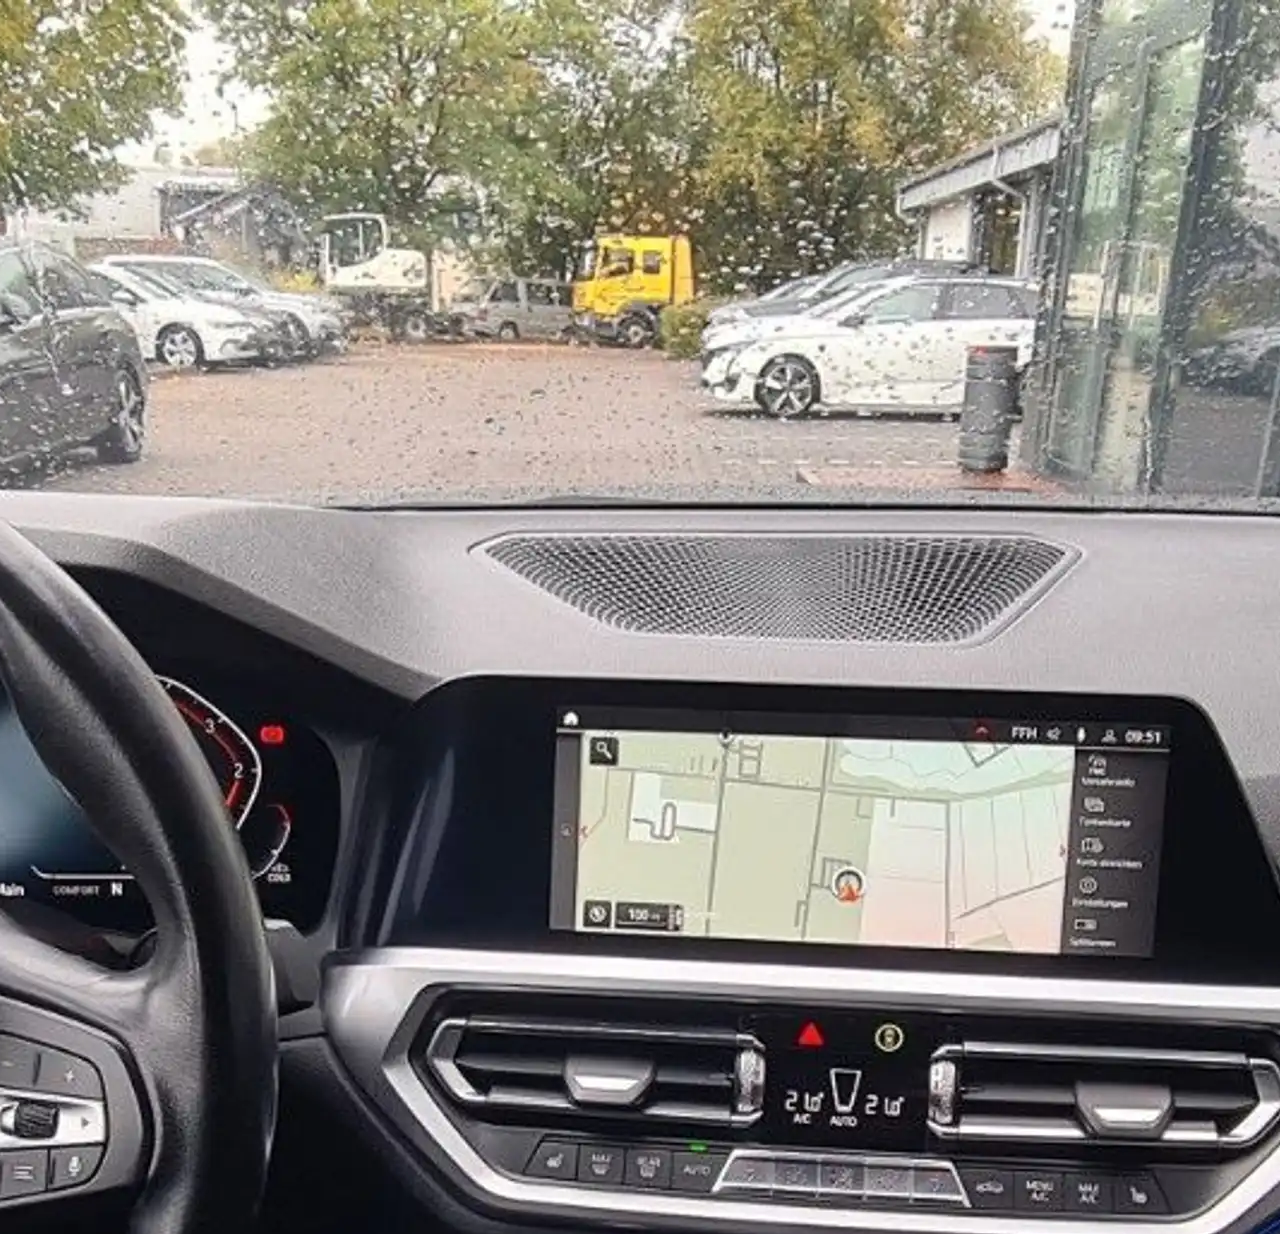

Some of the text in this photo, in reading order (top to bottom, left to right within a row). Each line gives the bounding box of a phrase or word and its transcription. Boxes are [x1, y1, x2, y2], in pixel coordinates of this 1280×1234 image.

[204, 718, 216, 734] 3
[1011, 726, 1038, 741] FFH
[1124, 730, 1162, 745] 09:51
[233, 762, 244, 779] 2
[52, 884, 100, 896] COMFORT
[111, 882, 123, 896] N
[829, 1115, 858, 1127] AUTO
